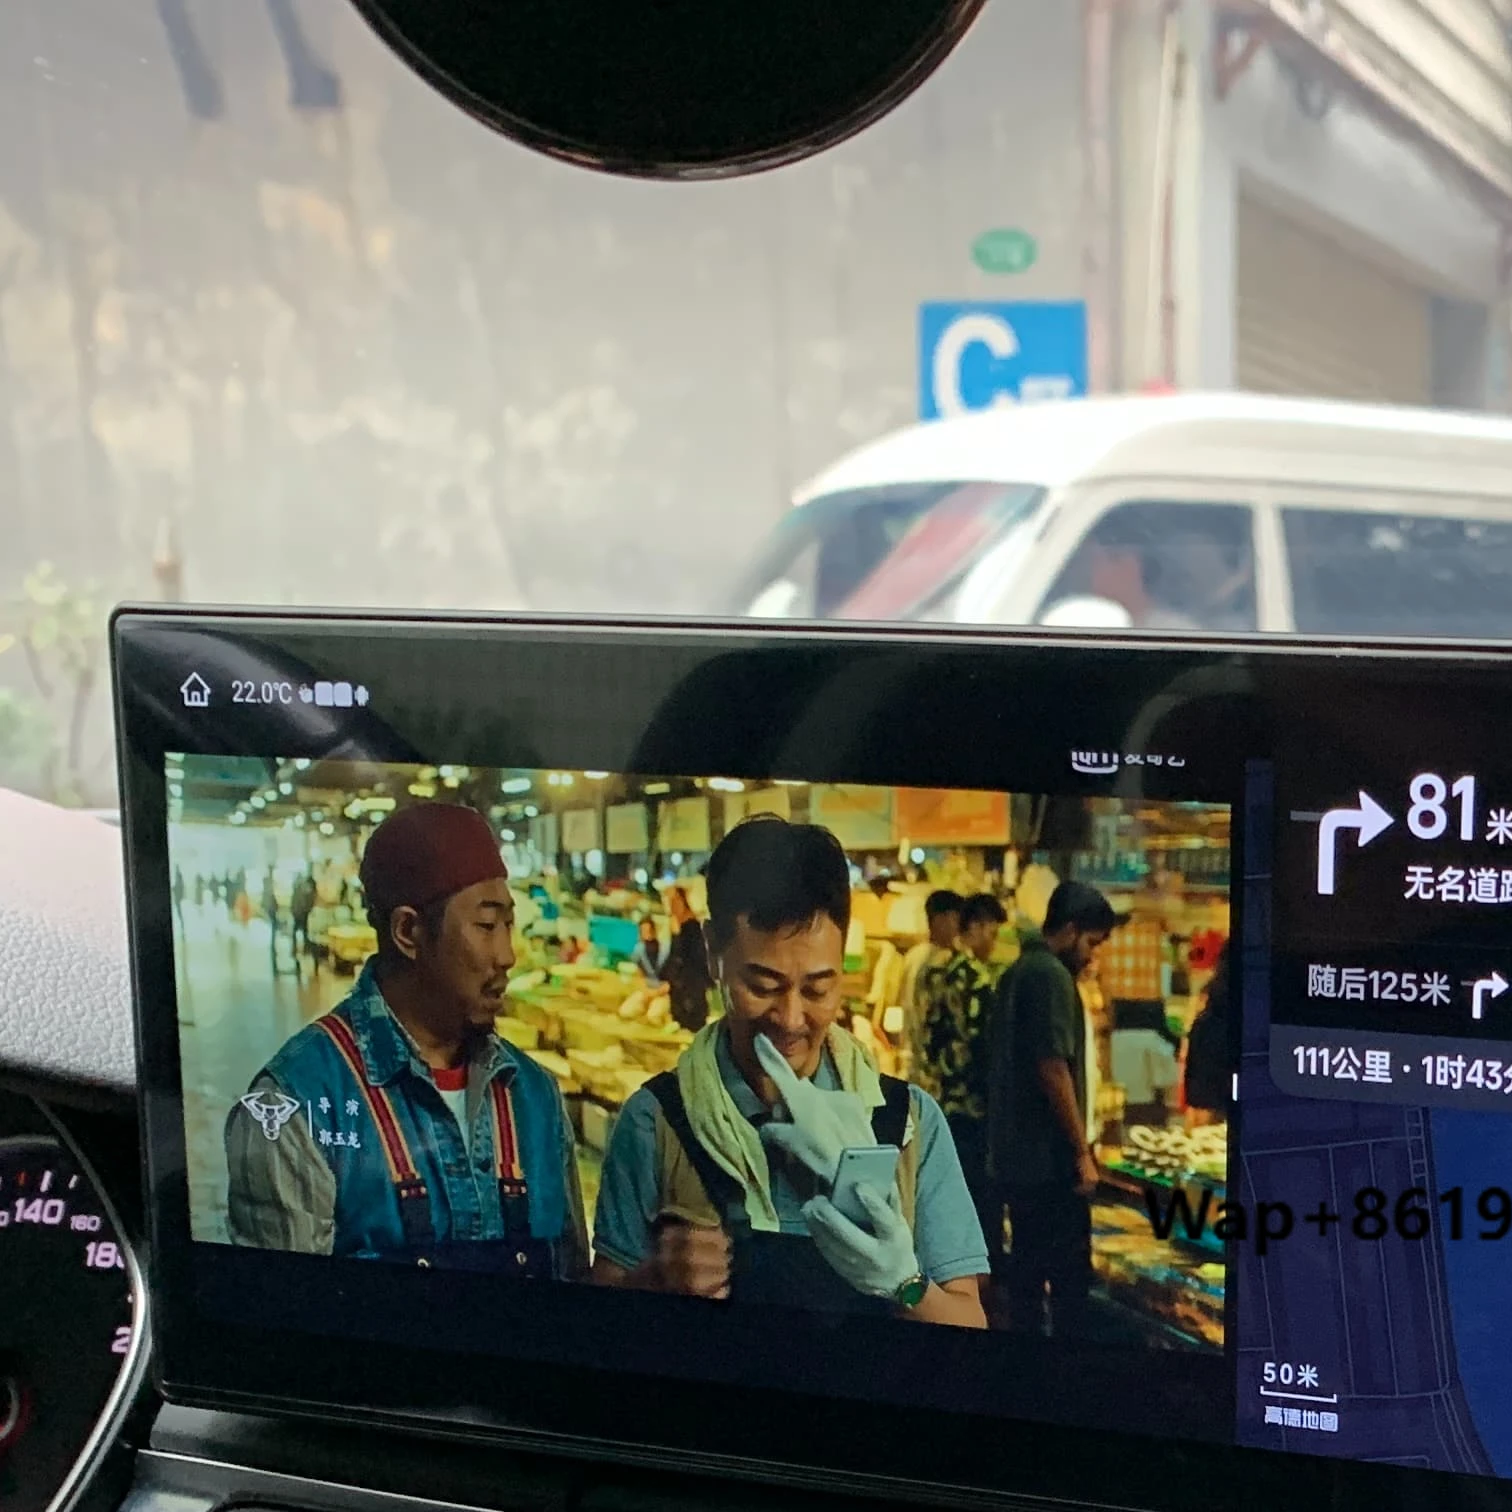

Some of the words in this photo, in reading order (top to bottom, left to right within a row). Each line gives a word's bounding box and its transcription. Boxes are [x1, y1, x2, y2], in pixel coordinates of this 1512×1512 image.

[1307, 964, 1451, 1006] 随后125米
[14, 1198, 65, 1225] 140
